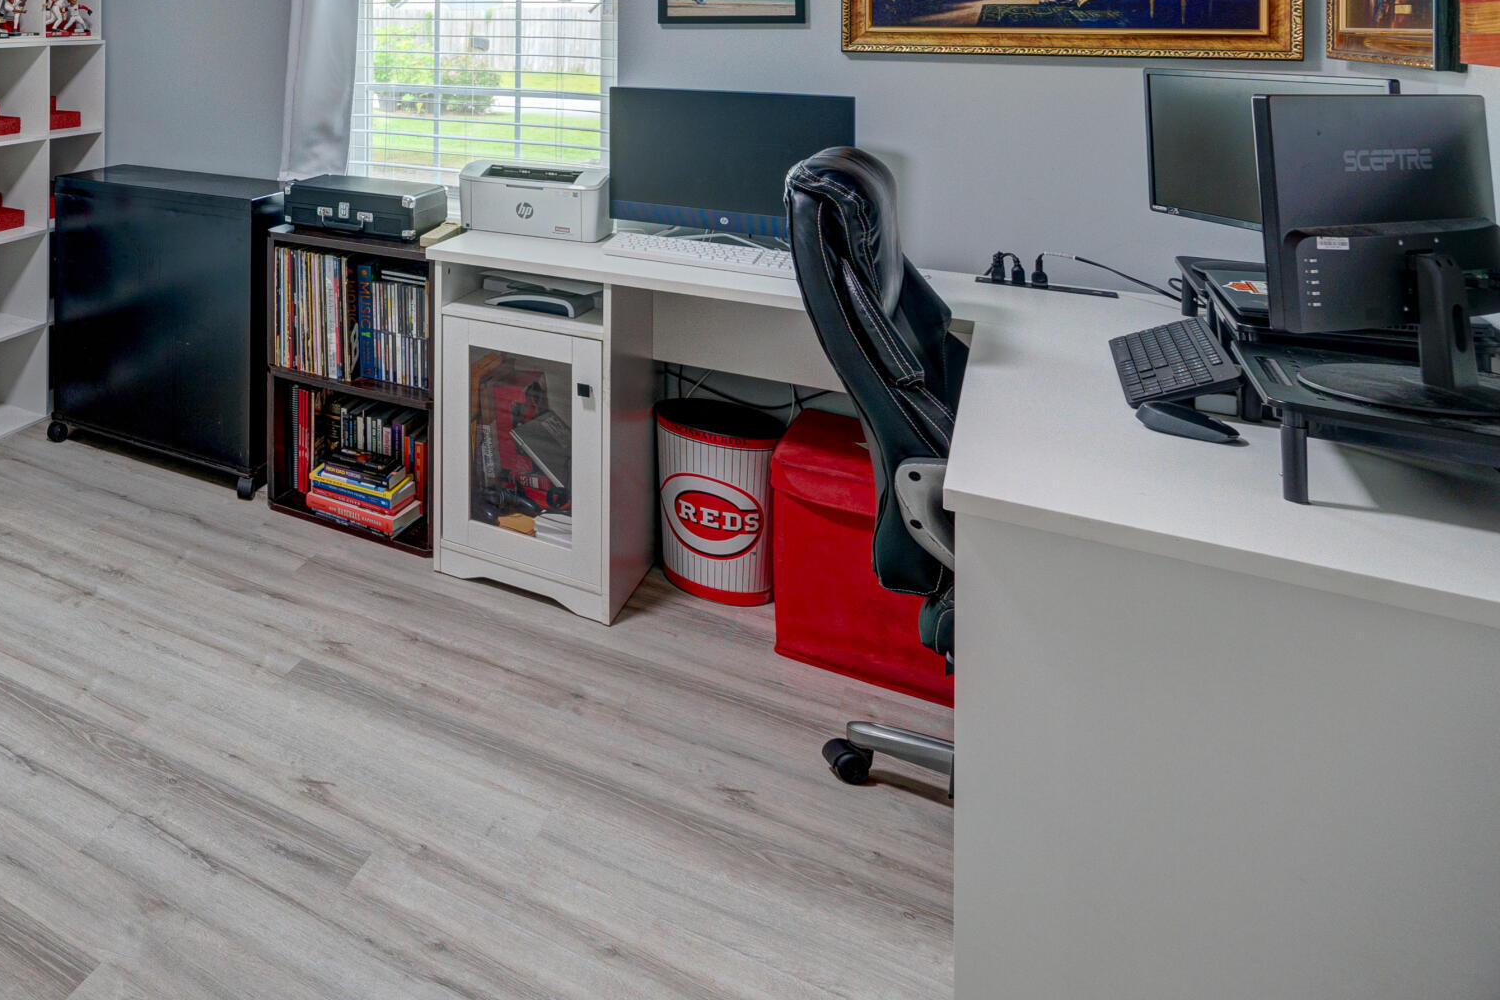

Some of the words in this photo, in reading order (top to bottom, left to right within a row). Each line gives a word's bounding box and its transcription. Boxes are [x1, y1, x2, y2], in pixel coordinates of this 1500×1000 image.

[1342, 148, 1435, 172] SCEPTRE
[515, 201, 534, 220] hp
[359, 281, 371, 330] MUSIC
[678, 499, 760, 532] REDS
